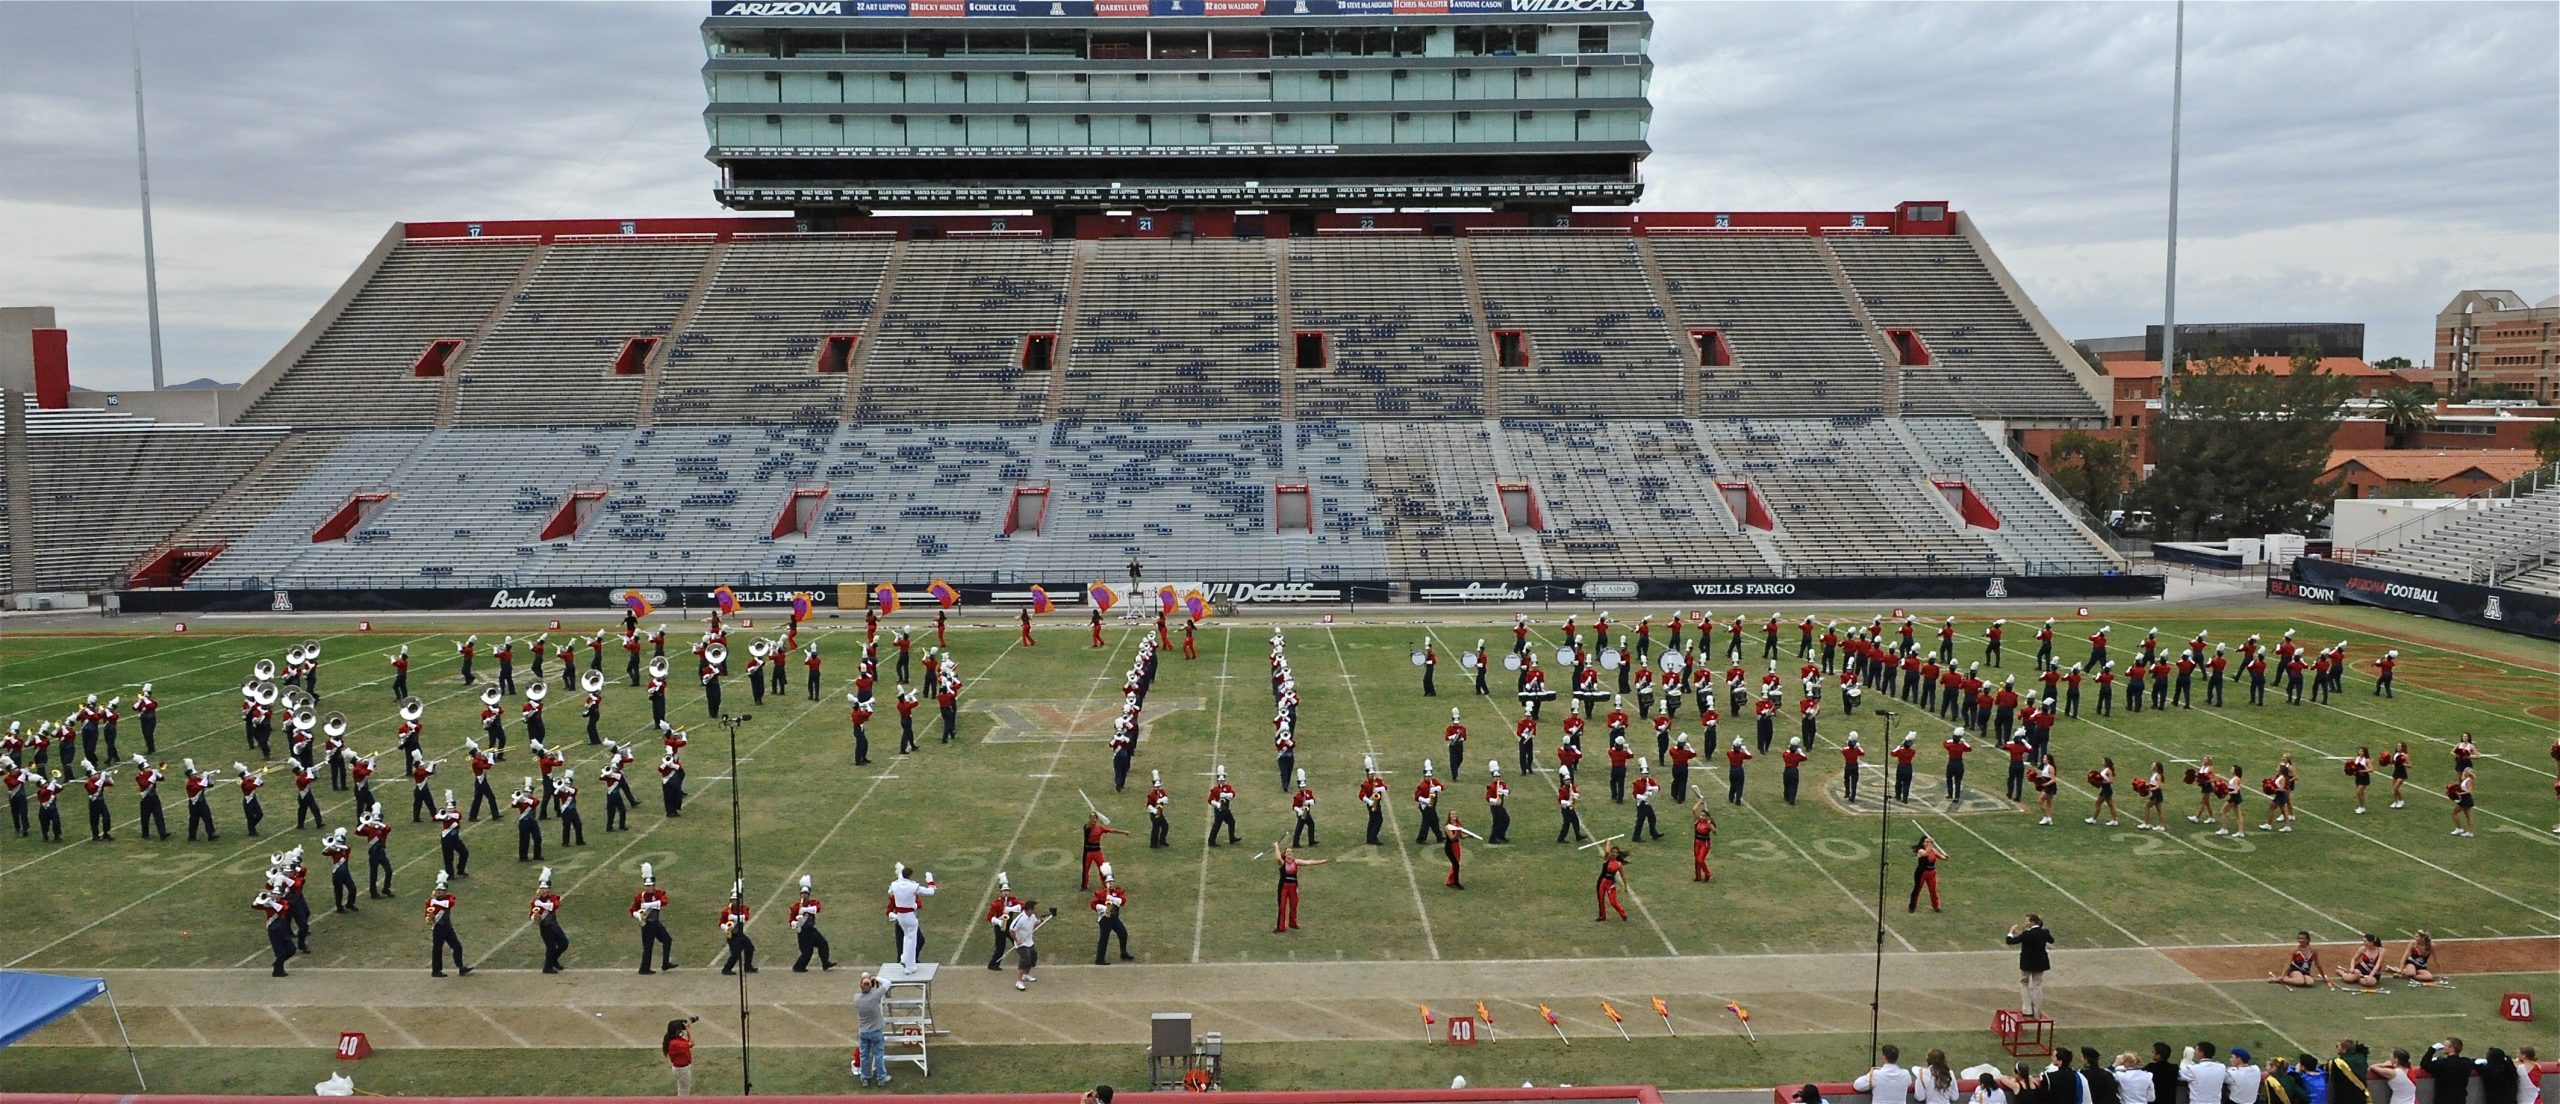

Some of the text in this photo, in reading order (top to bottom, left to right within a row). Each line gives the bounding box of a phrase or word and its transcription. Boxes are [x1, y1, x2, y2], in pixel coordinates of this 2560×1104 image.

[725, 2, 842, 15] ARIZONA
[919, 3, 938, 11] RICKY
[939, 3, 963, 11] HUNLEY
[1400, 0, 1417, 8] CHRIS
[1418, 0, 1447, 8] McALISTER
[1511, 0, 1637, 11] WILDCATS
[796, 224, 807, 233] 19
[992, 222, 1005, 231] 20
[1140, 221, 1151, 230] 21
[1361, 220, 1373, 229] 22
[1557, 219, 1569, 228] 23
[1716, 219, 1728, 228] 24
[1852, 219, 1864, 228] 25
[470, 228, 480, 237] 17
[622, 226, 634, 235] 18
[107, 396, 118, 405] 16
[1692, 584, 1796, 595] WELLS FARGO
[2271, 581, 2335, 602] BEAR DOWN
[2346, 577, 2439, 603] ARIZONA FOOTBALL
[490, 589, 556, 608] Bashas'
[1728, 837, 1871, 861] 30
[2110, 832, 2256, 855] 20
[932, 847, 1075, 871] 50
[2510, 999, 2530, 1017] 20
[1452, 1021, 1471, 1040] 40
[904, 1030, 918, 1045] 50
[340, 1036, 358, 1056] 40
